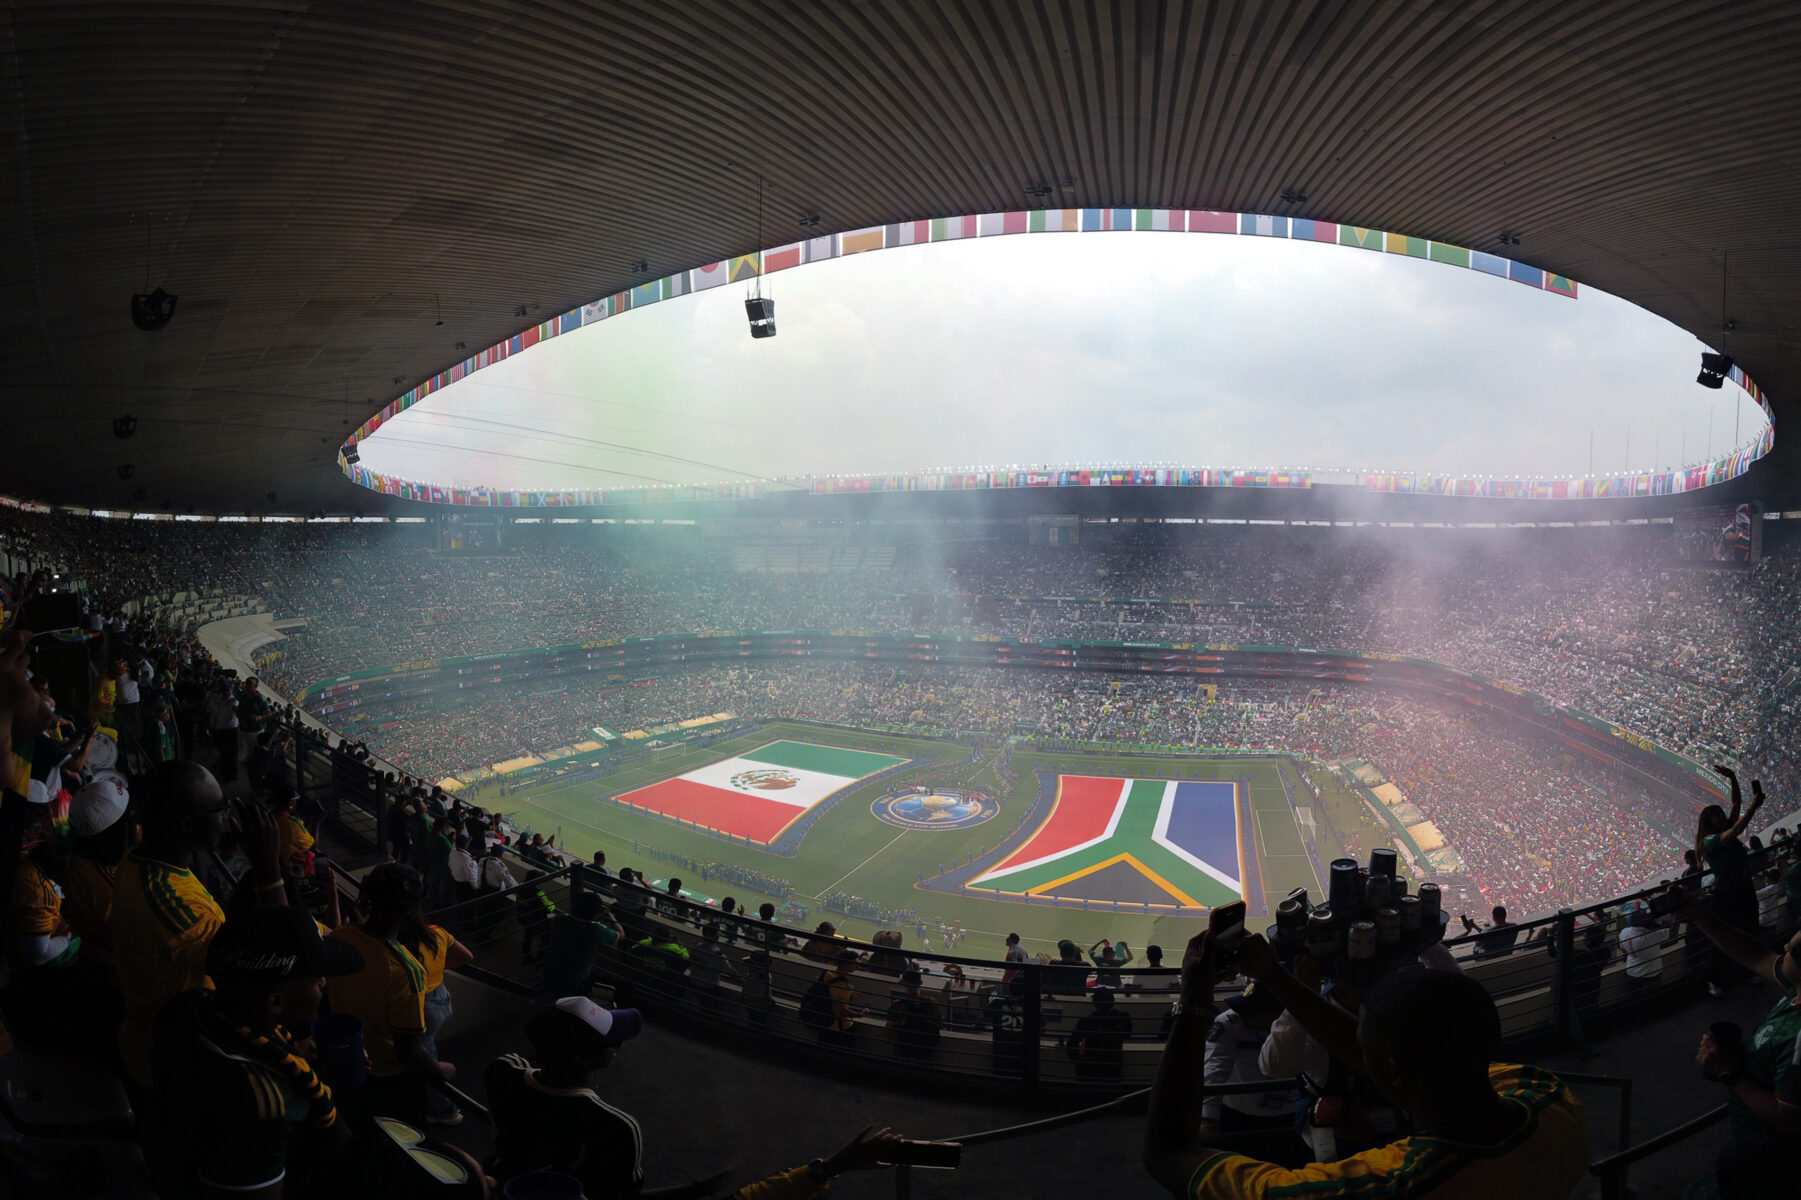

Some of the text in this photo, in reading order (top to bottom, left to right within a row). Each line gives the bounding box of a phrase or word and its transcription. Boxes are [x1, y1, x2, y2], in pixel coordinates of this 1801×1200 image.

[1696, 767, 1729, 795] MEXICO CITY
[229, 949, 298, 977] Building
[1001, 1014, 1025, 1032] 20
